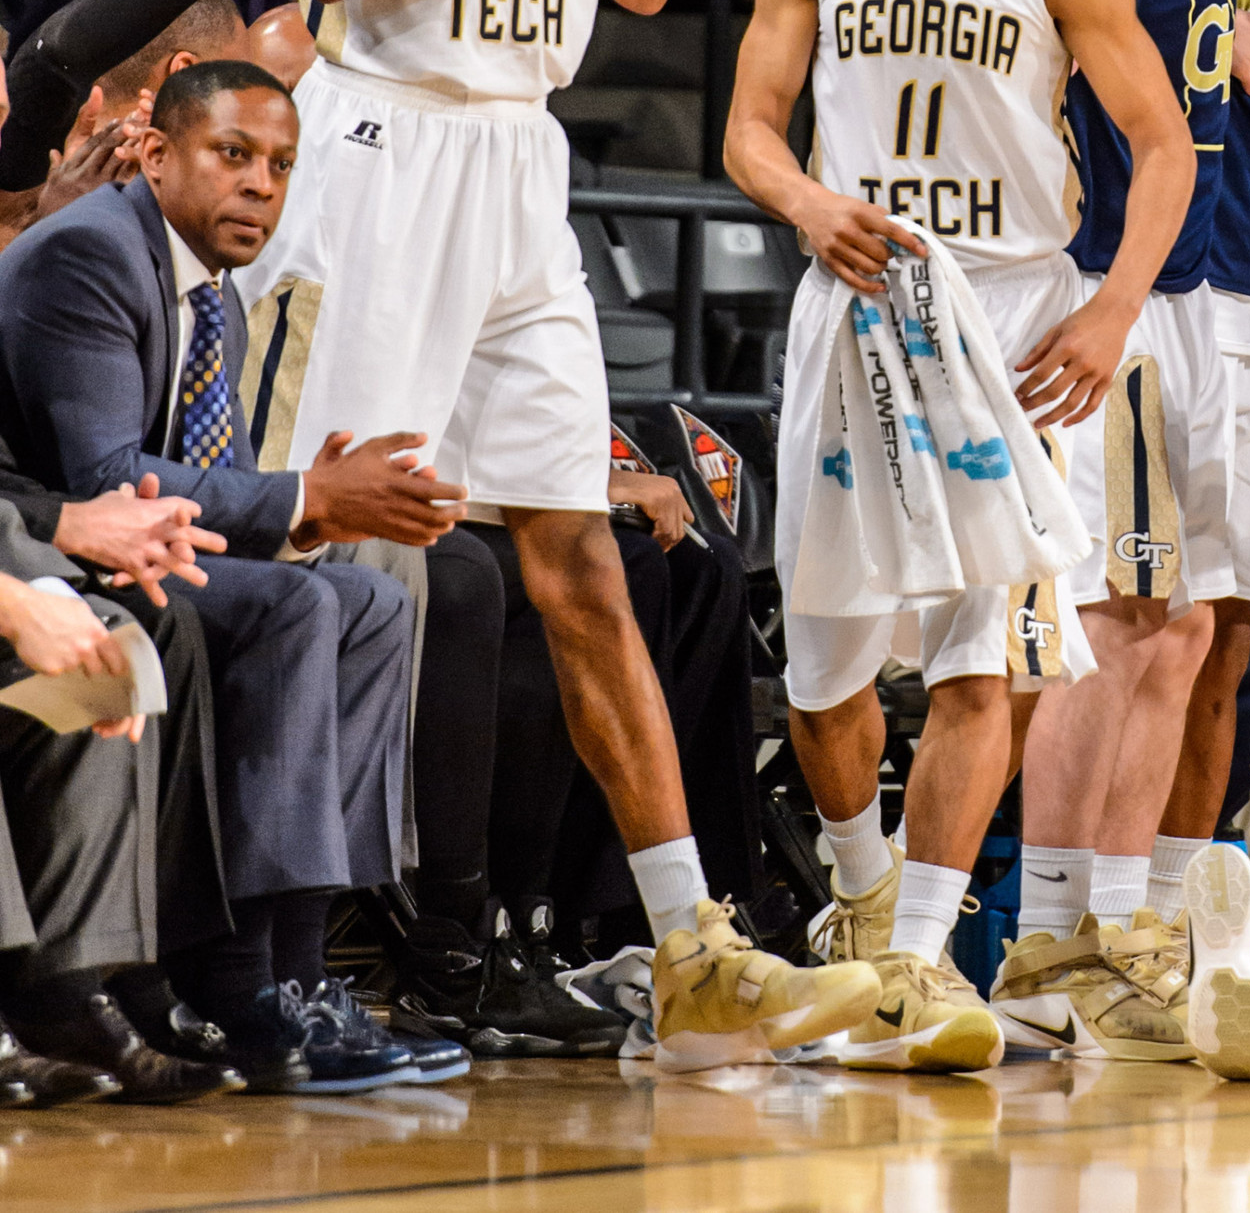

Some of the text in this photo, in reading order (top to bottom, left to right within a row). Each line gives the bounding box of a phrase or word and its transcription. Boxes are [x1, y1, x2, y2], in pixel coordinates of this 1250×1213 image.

[892, 78, 948, 160] 11
[343, 134, 384, 150] RUSSELL
[1115, 531, 1174, 569] GT
[1014, 606, 1056, 649] GT
